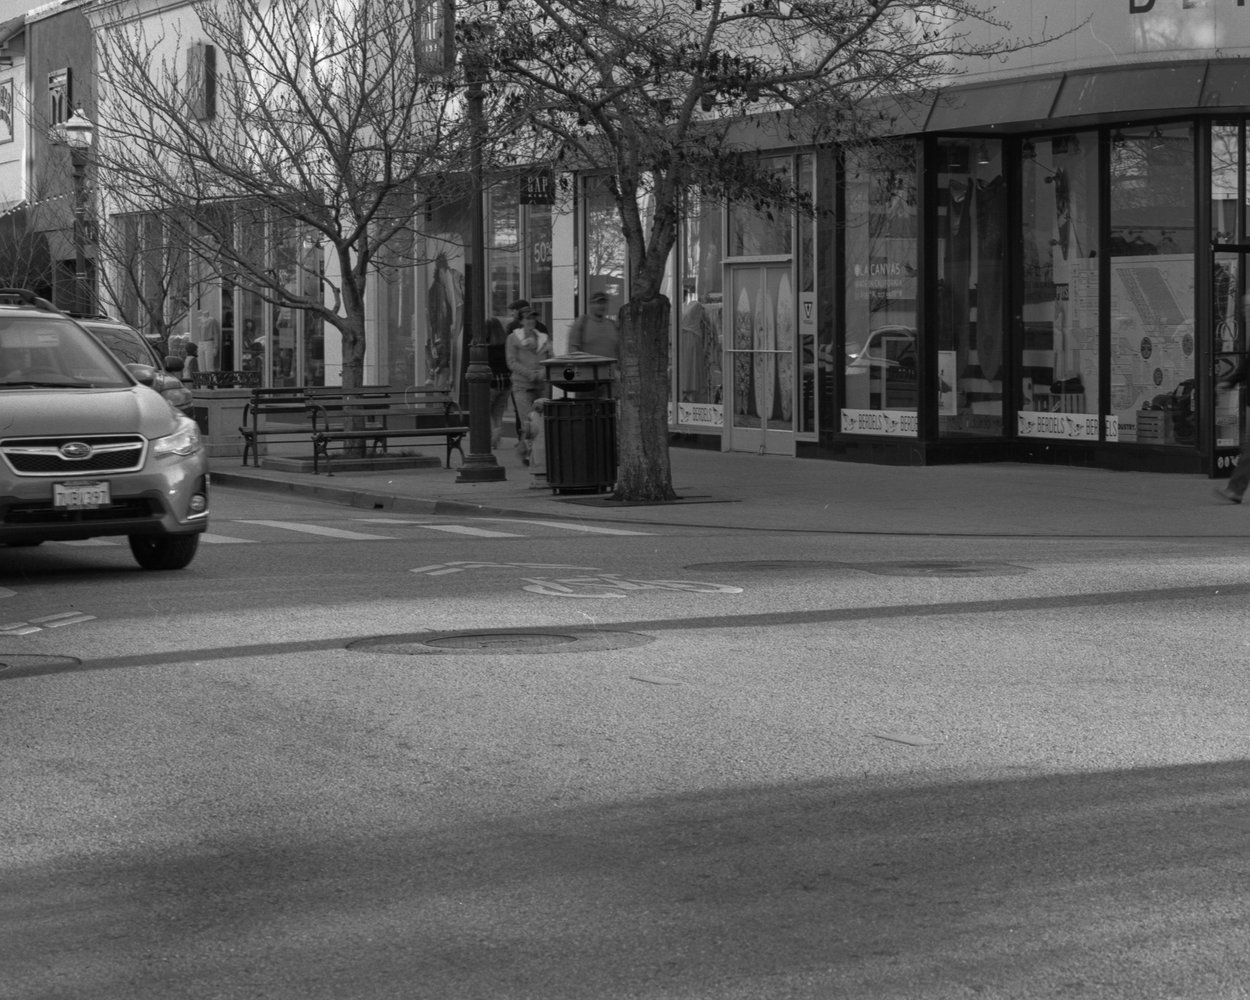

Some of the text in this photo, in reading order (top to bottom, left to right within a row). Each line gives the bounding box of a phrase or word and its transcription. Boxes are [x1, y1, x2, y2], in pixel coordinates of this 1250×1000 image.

[870, 263, 900, 276] CANVAS
[858, 414, 882, 430] BERDELS
[1036, 416, 1065, 434] BERDELS
